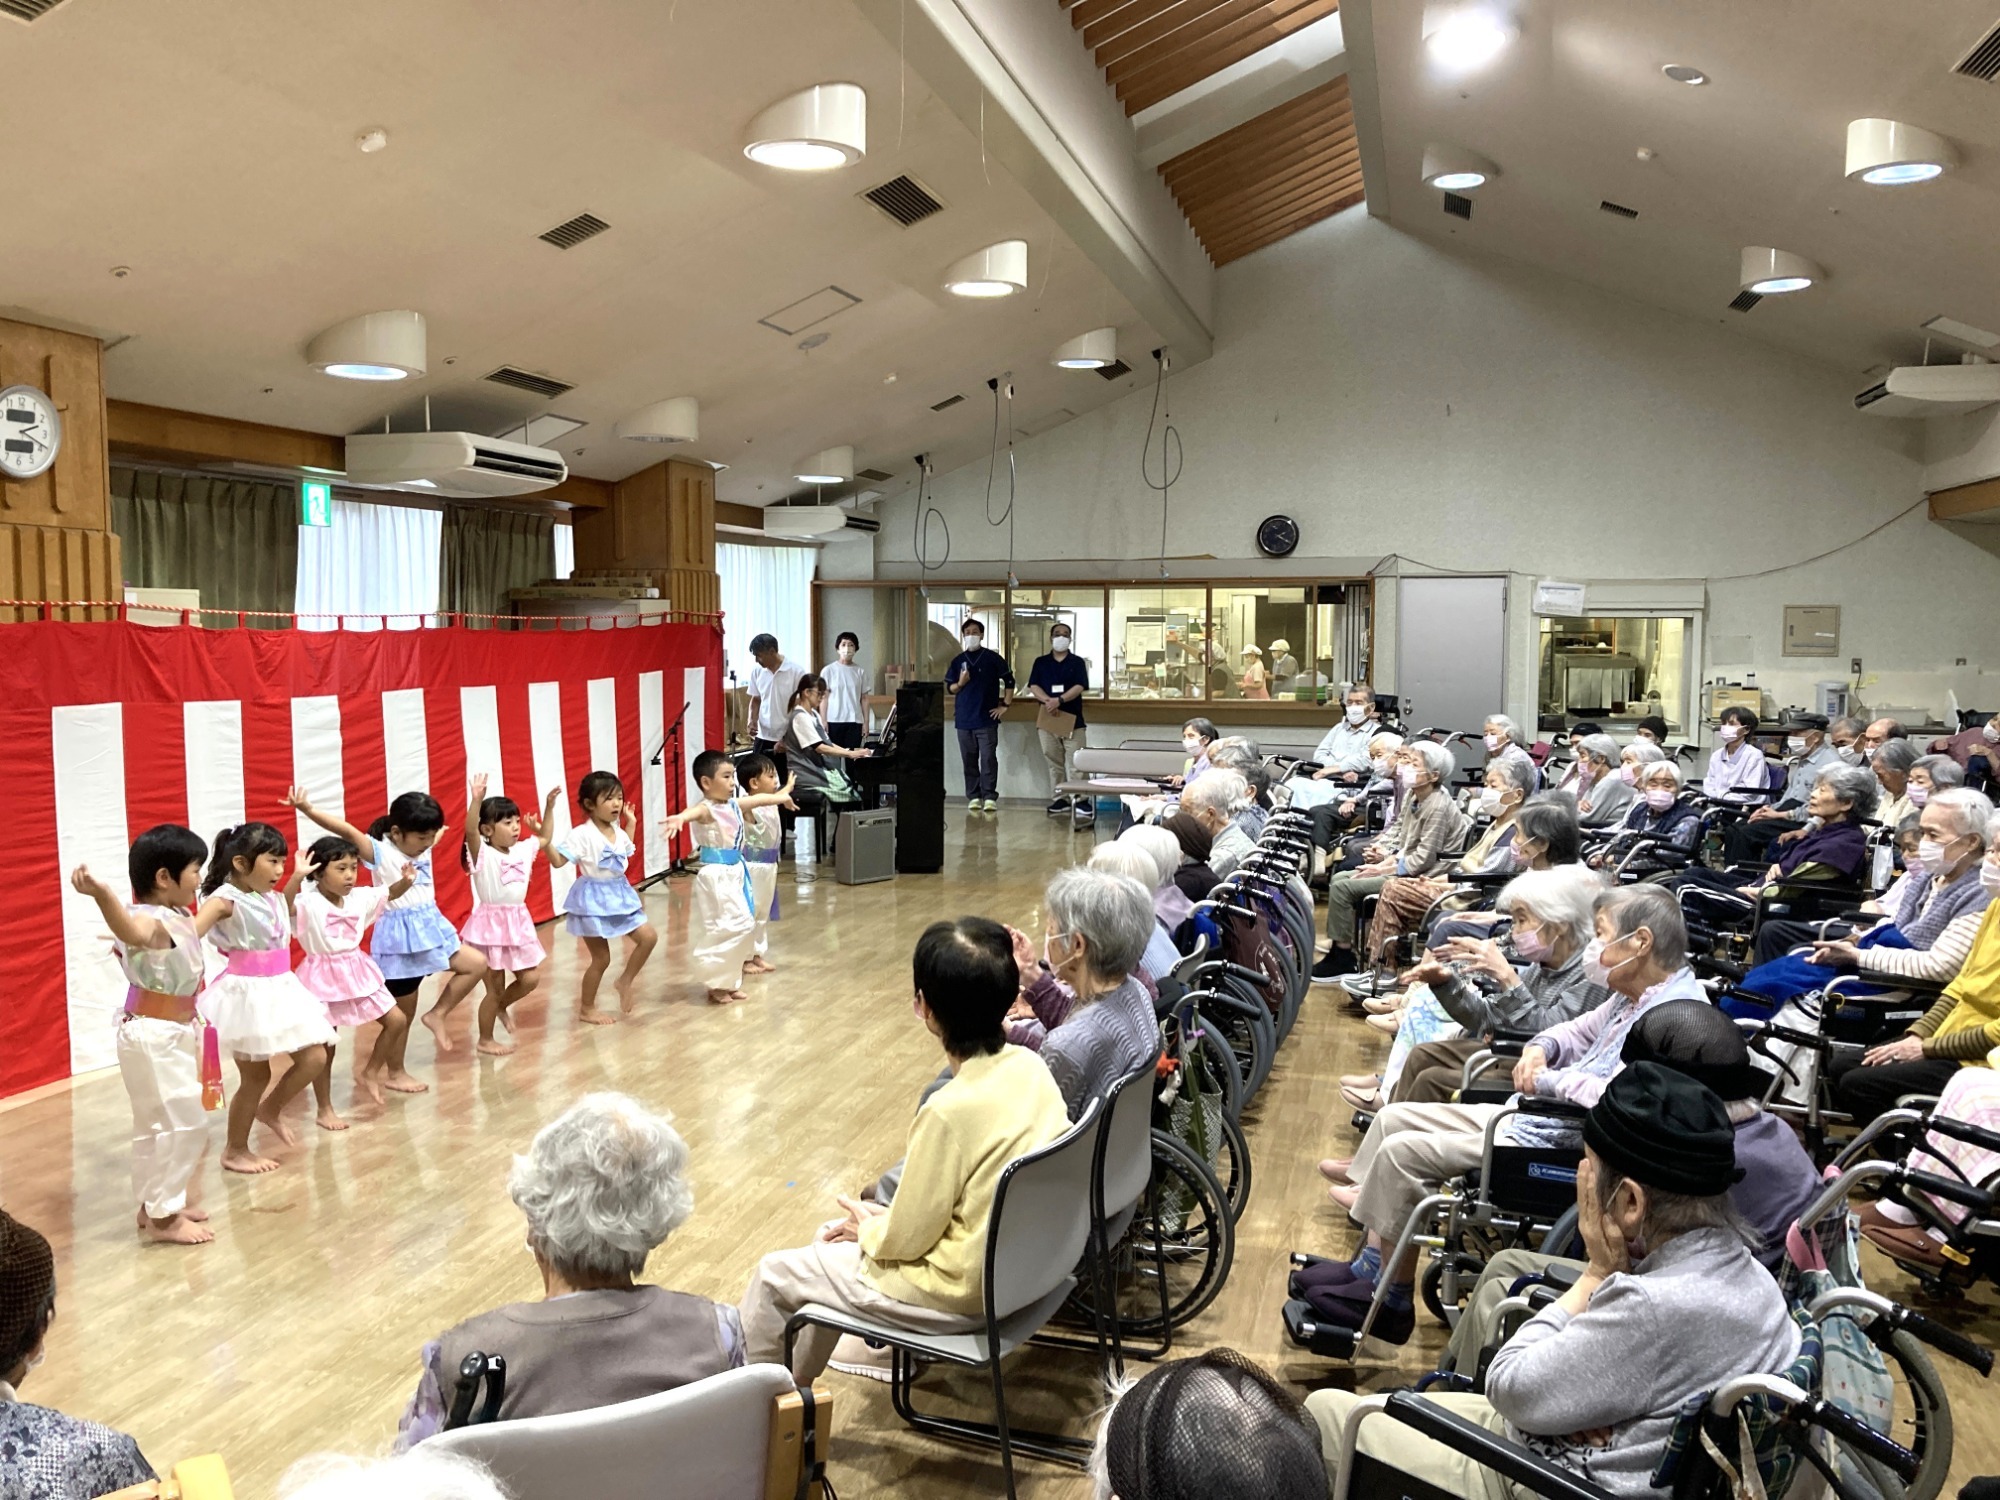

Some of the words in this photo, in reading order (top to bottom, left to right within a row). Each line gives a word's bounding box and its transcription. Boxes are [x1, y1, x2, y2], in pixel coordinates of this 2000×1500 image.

[6, 397, 13, 408] 11
[18, 396, 26, 407] 12
[40, 414, 45, 423] 2
[42, 429, 48, 439] 3
[38, 443, 43, 452] 4
[5, 452, 10, 461] 7
[16, 456, 22, 466] 6
[29, 455, 34, 464] 5
